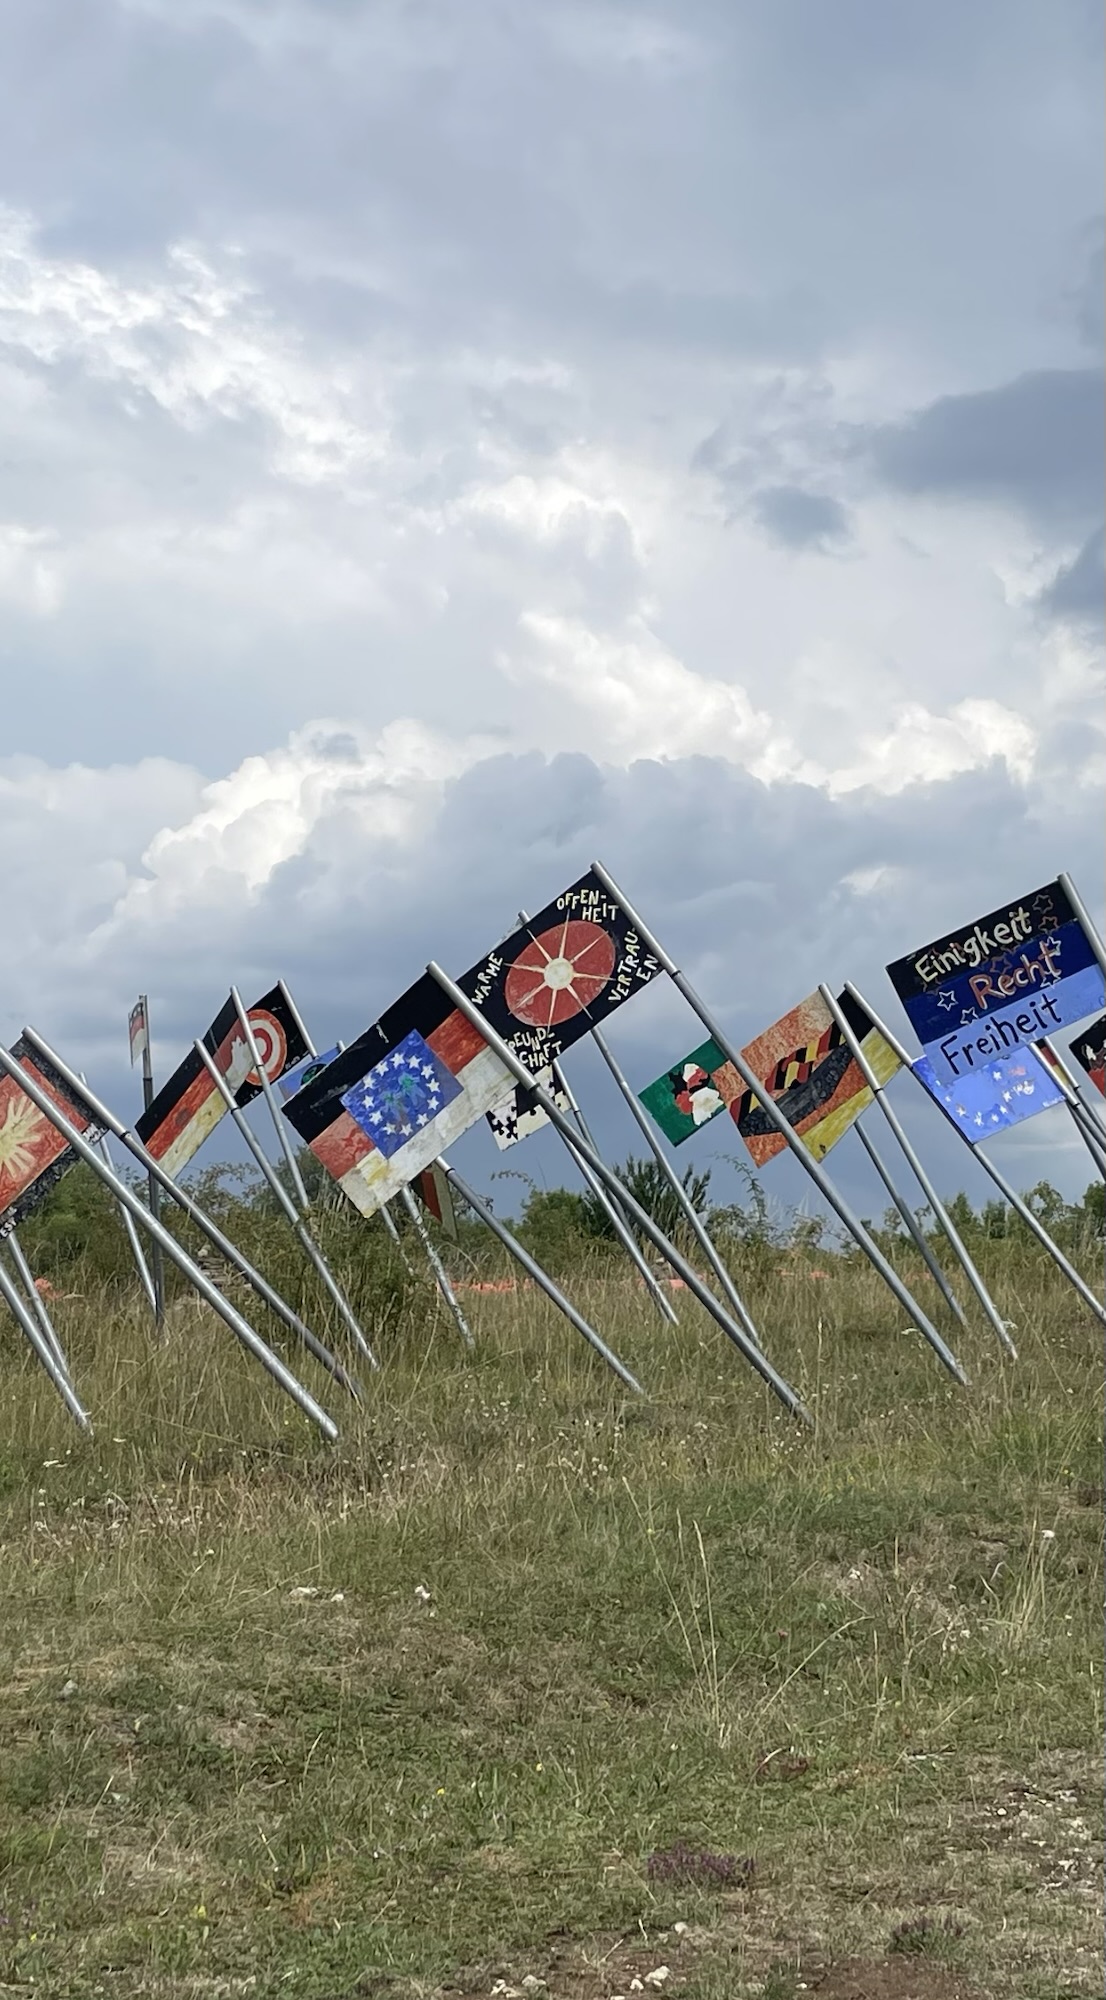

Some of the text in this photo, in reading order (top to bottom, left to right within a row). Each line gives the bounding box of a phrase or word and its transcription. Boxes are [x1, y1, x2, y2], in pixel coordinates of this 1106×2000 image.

[556, 889, 607, 910] OFFEN-
[582, 902, 619, 923] HEIT
[915, 906, 1032, 983] Einigkeit
[635, 953, 659, 981] EN
[969, 940, 1062, 1010] Recht
[940, 993, 1062, 1075] Freiheit
[519, 1040, 562, 1068] CHAFT
